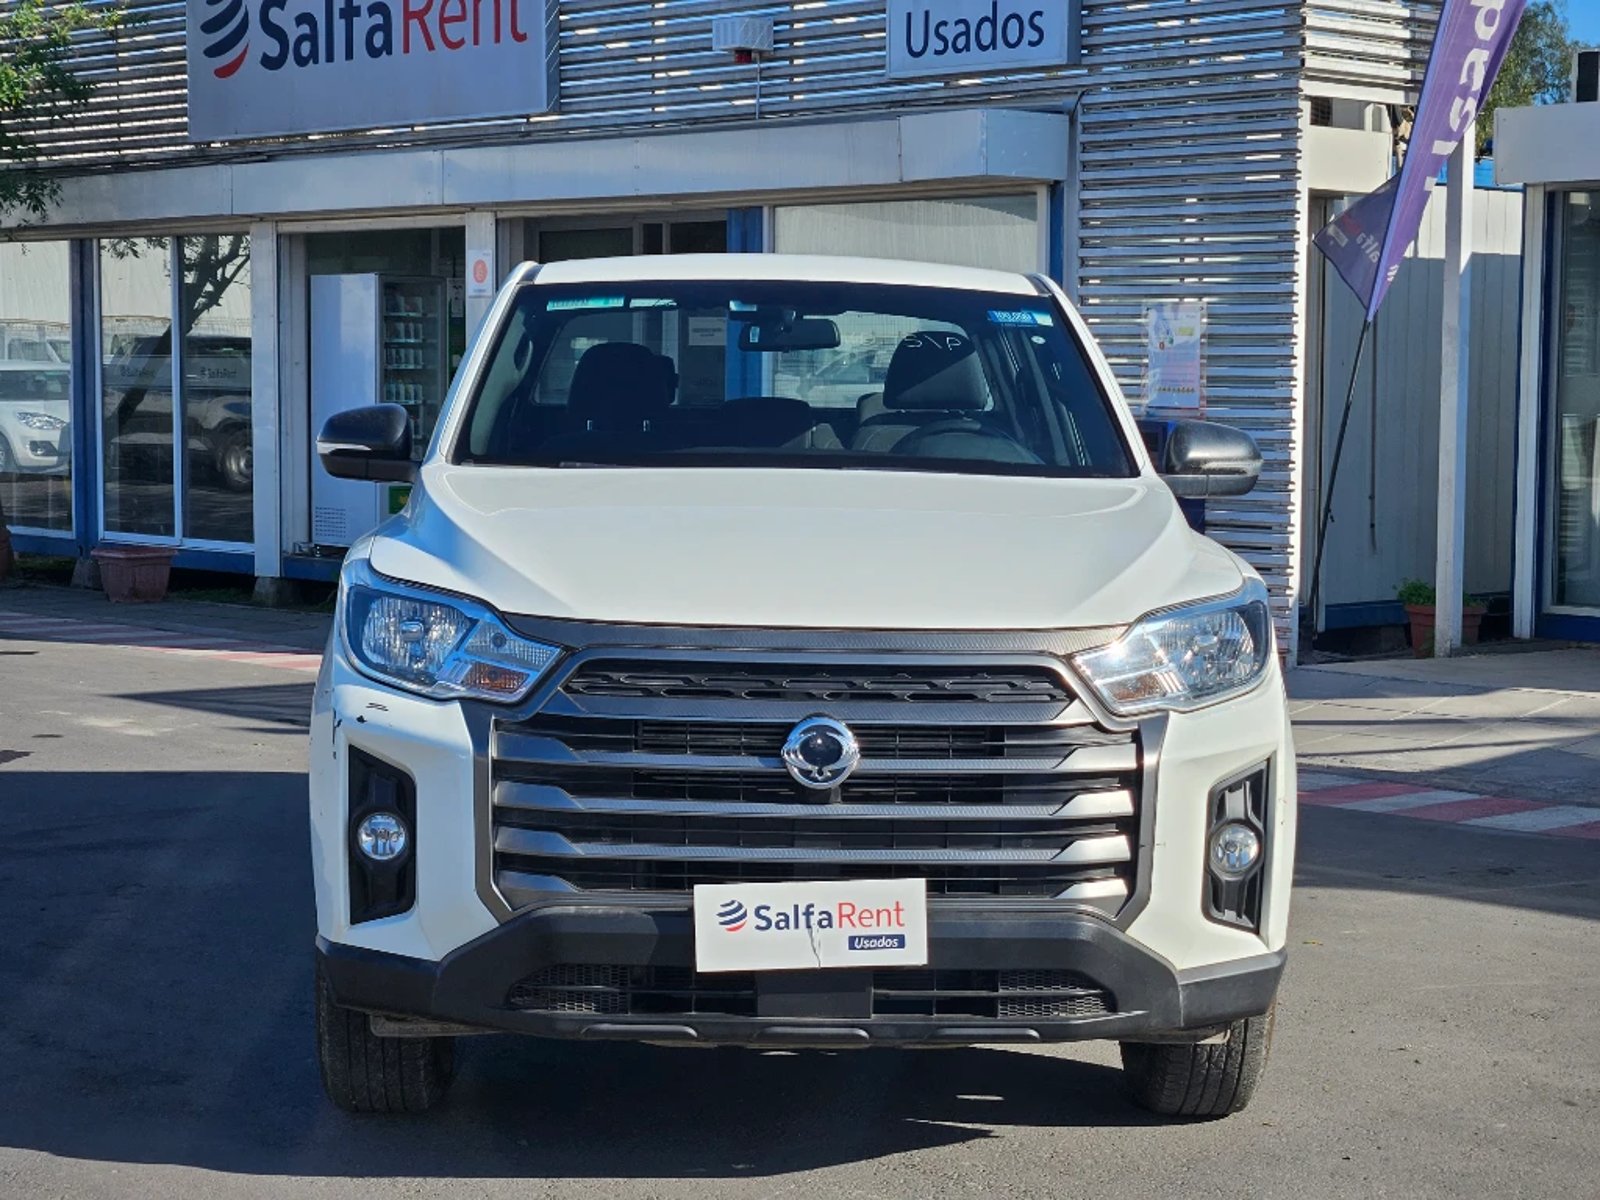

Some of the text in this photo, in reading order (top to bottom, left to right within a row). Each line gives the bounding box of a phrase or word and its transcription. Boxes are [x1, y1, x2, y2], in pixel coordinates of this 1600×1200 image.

[259, 0, 528, 71] SalfaRent
[905, 0, 1045, 59] Usados
[754, 901, 905, 931] SalfaRent
[854, 936, 899, 949] Usados
